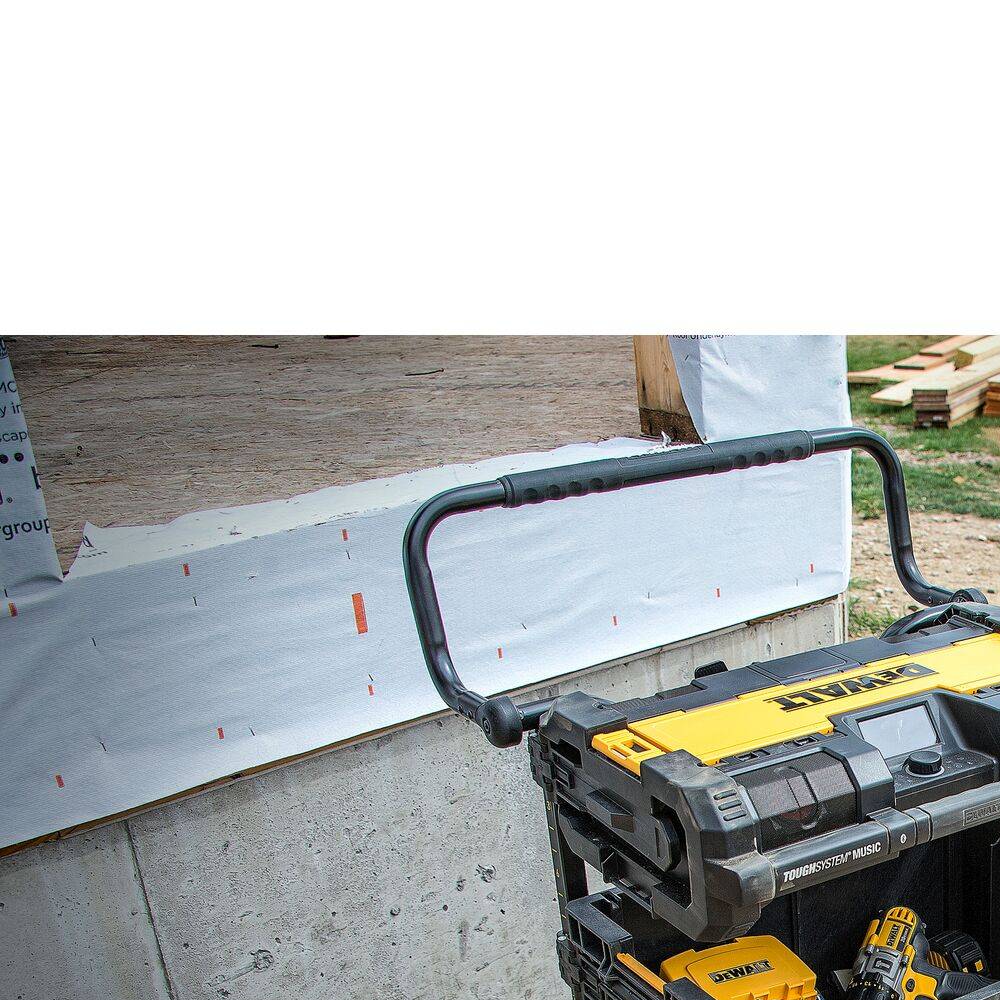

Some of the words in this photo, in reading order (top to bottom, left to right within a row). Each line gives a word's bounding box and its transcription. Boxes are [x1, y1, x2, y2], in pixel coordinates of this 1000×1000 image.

[771, 662, 939, 712] DEWALT
[853, 841, 882, 861] MUSIC
[708, 959, 774, 984] DEWALT
